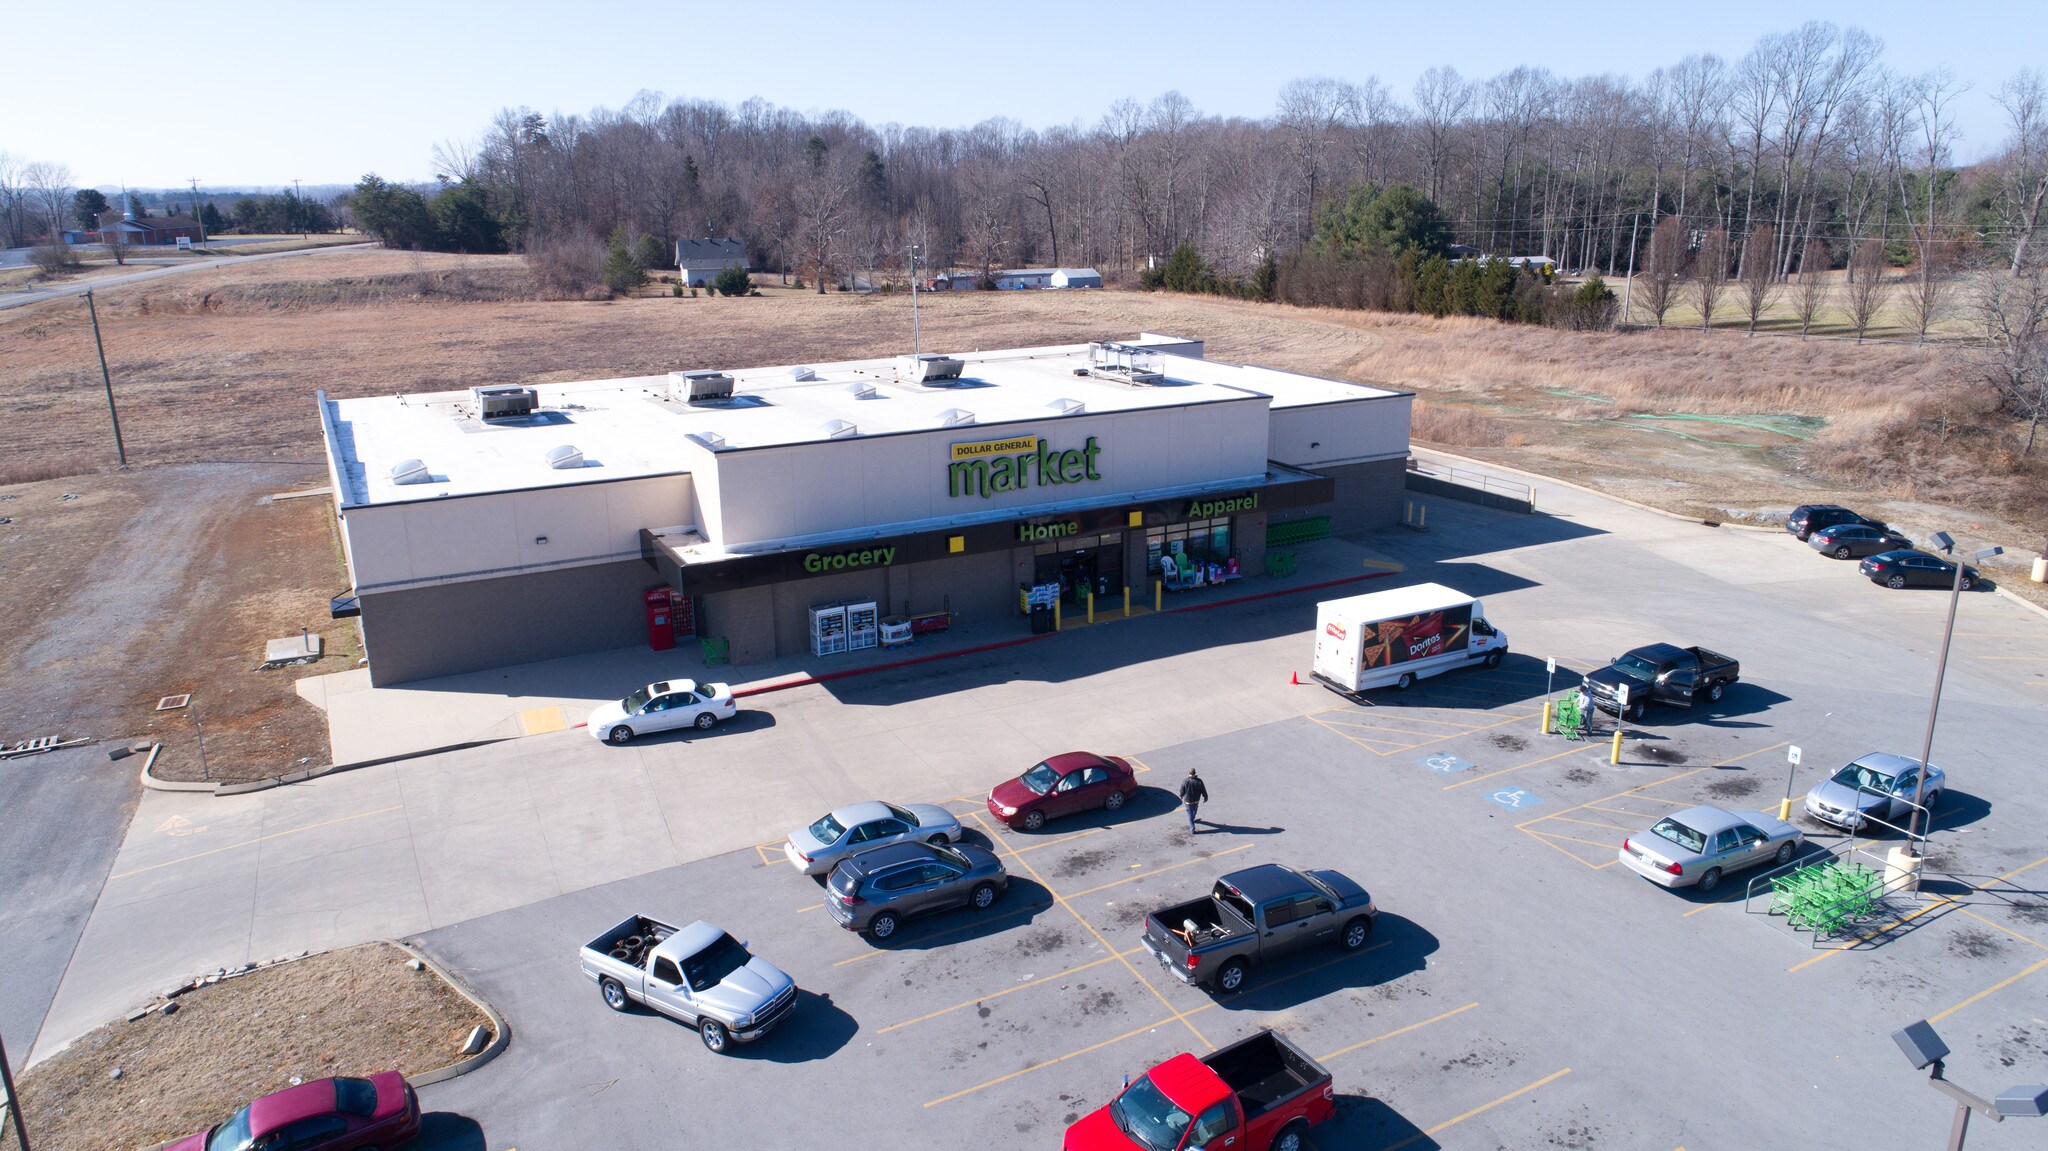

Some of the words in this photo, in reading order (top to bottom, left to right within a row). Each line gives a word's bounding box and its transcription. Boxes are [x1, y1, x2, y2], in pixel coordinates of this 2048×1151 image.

[957, 444, 991, 455] DOLLAR
[994, 440, 1032, 451] GENERAL
[948, 436, 1101, 499] market
[1188, 492, 1258, 519] Apparel
[1020, 521, 1078, 542] Home
[804, 547, 896, 573] Grocery
[1409, 633, 1441, 656] Doritos
